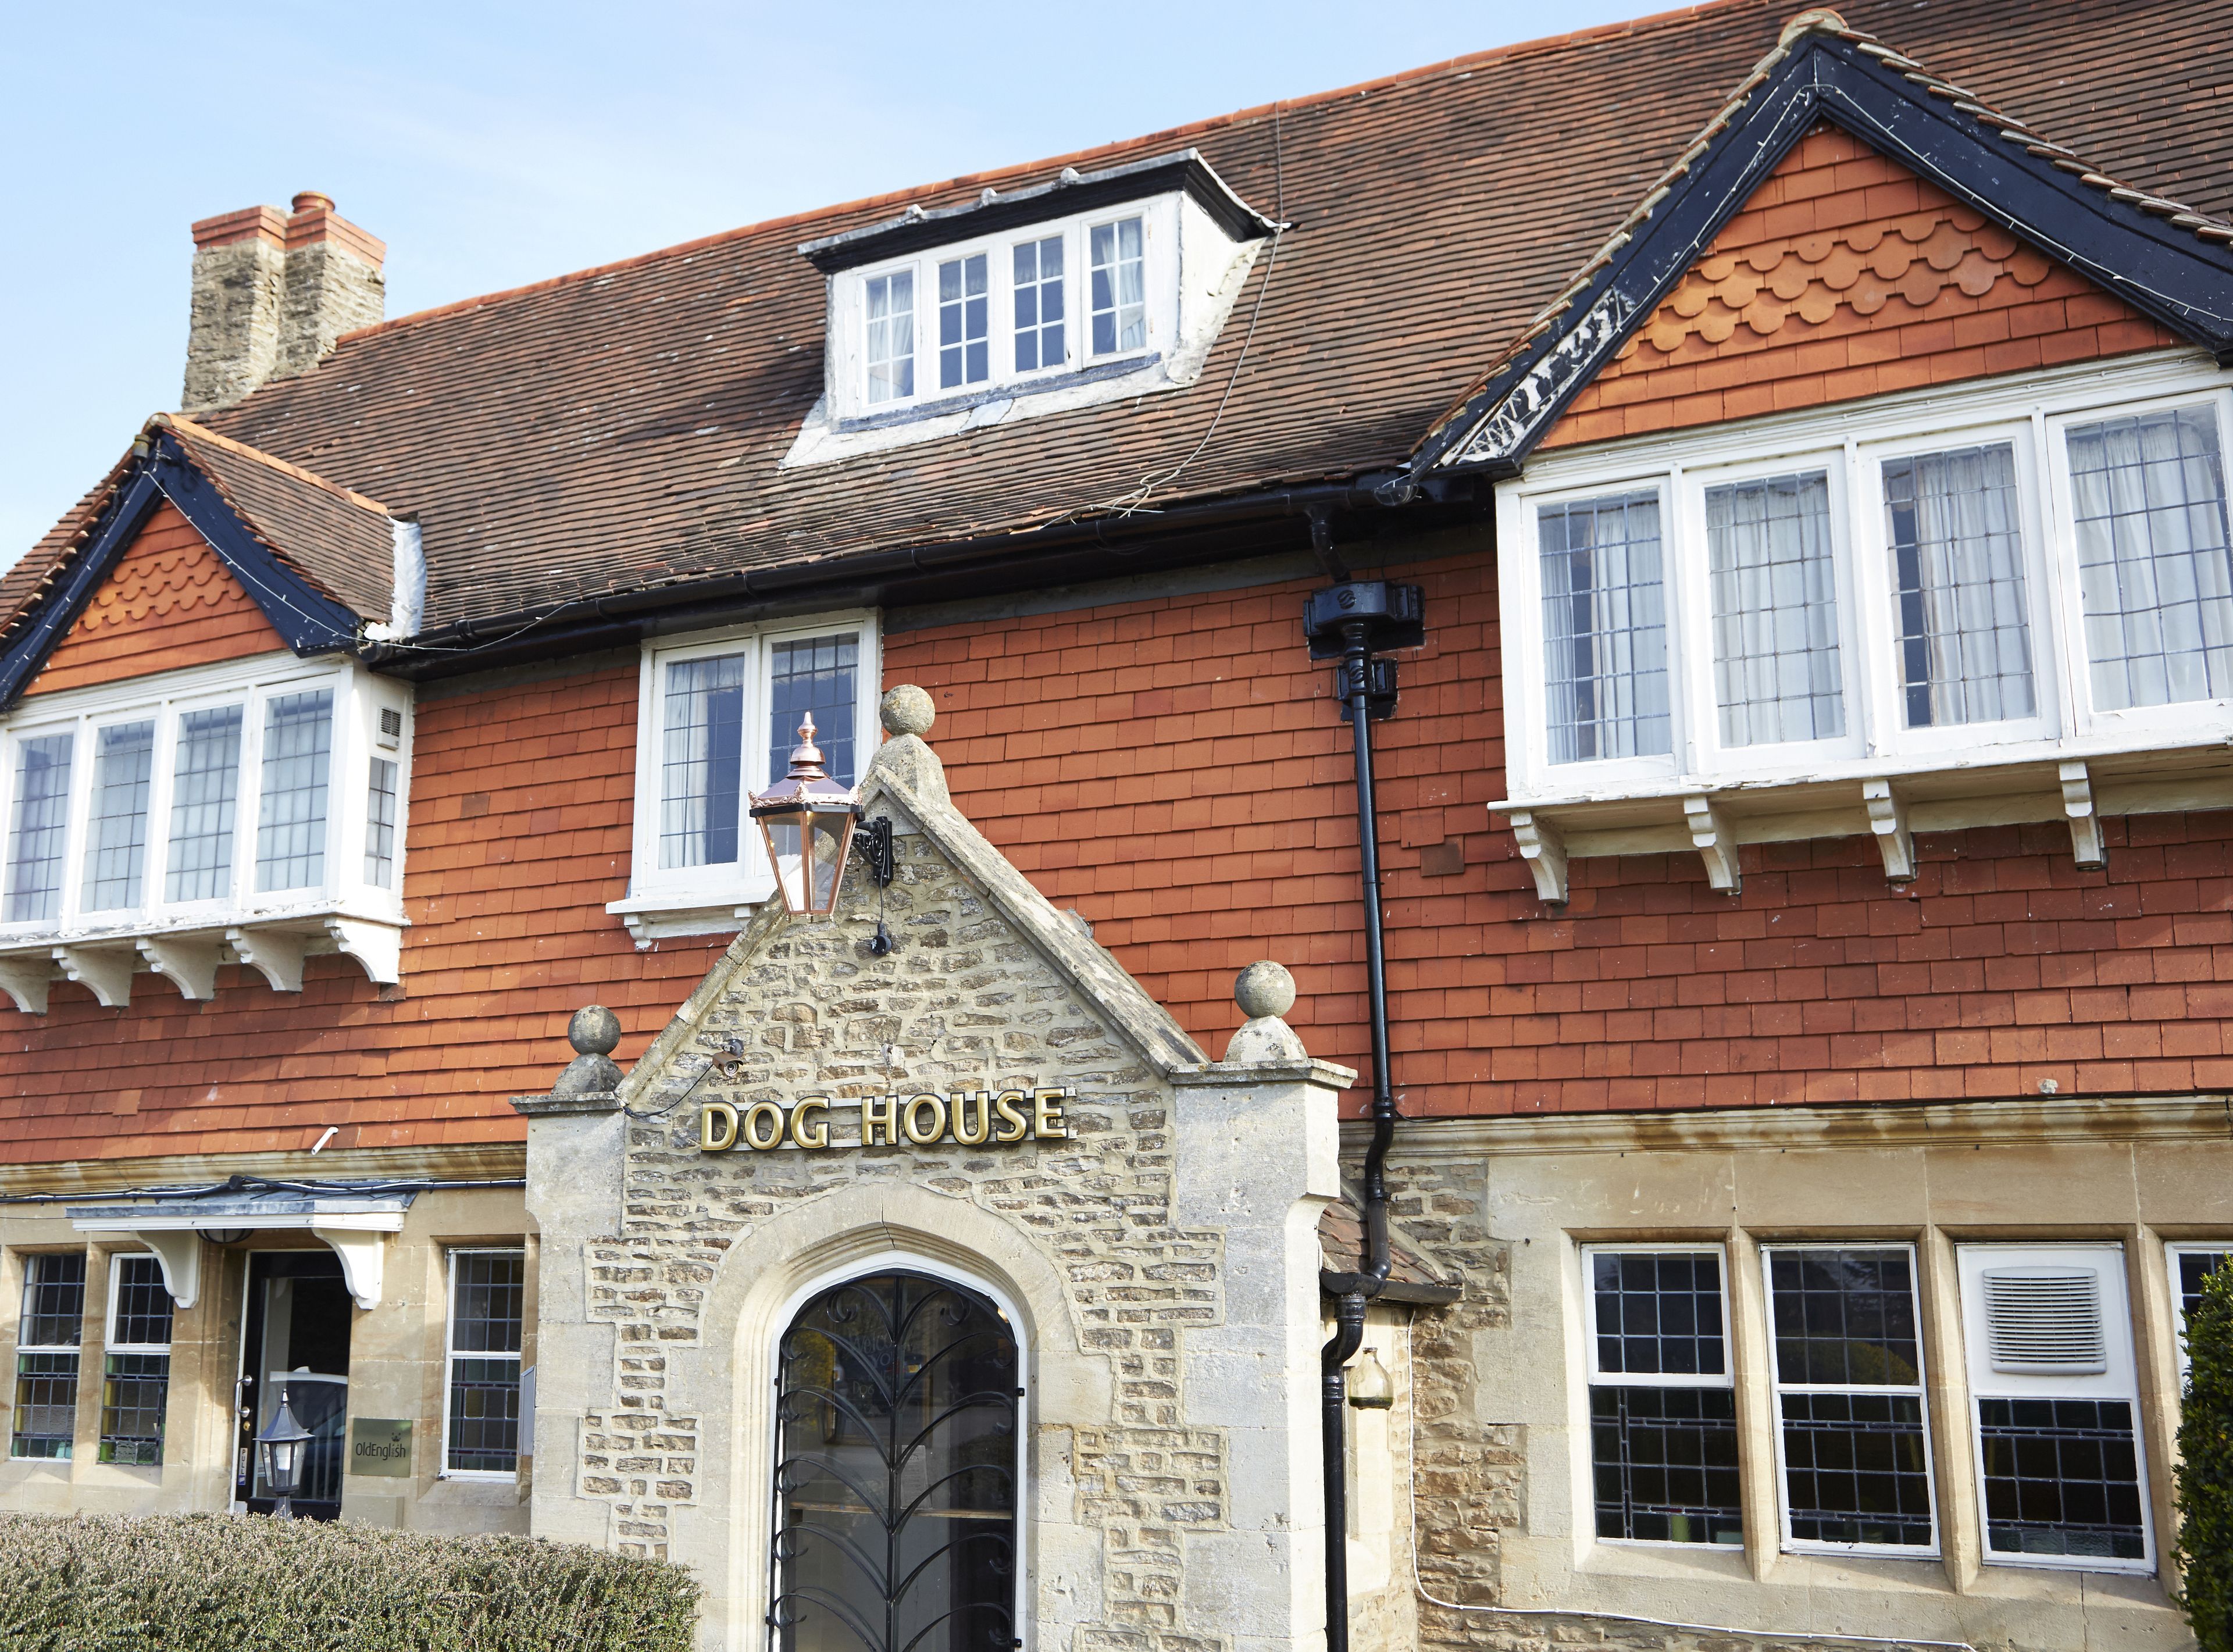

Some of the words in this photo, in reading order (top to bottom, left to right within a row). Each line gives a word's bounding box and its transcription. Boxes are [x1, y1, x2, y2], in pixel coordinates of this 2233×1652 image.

[701, 1095, 830, 1153] DOG
[861, 1087, 1068, 1147] HOUSE
[355, 1442, 406, 1461] OldEnglish
